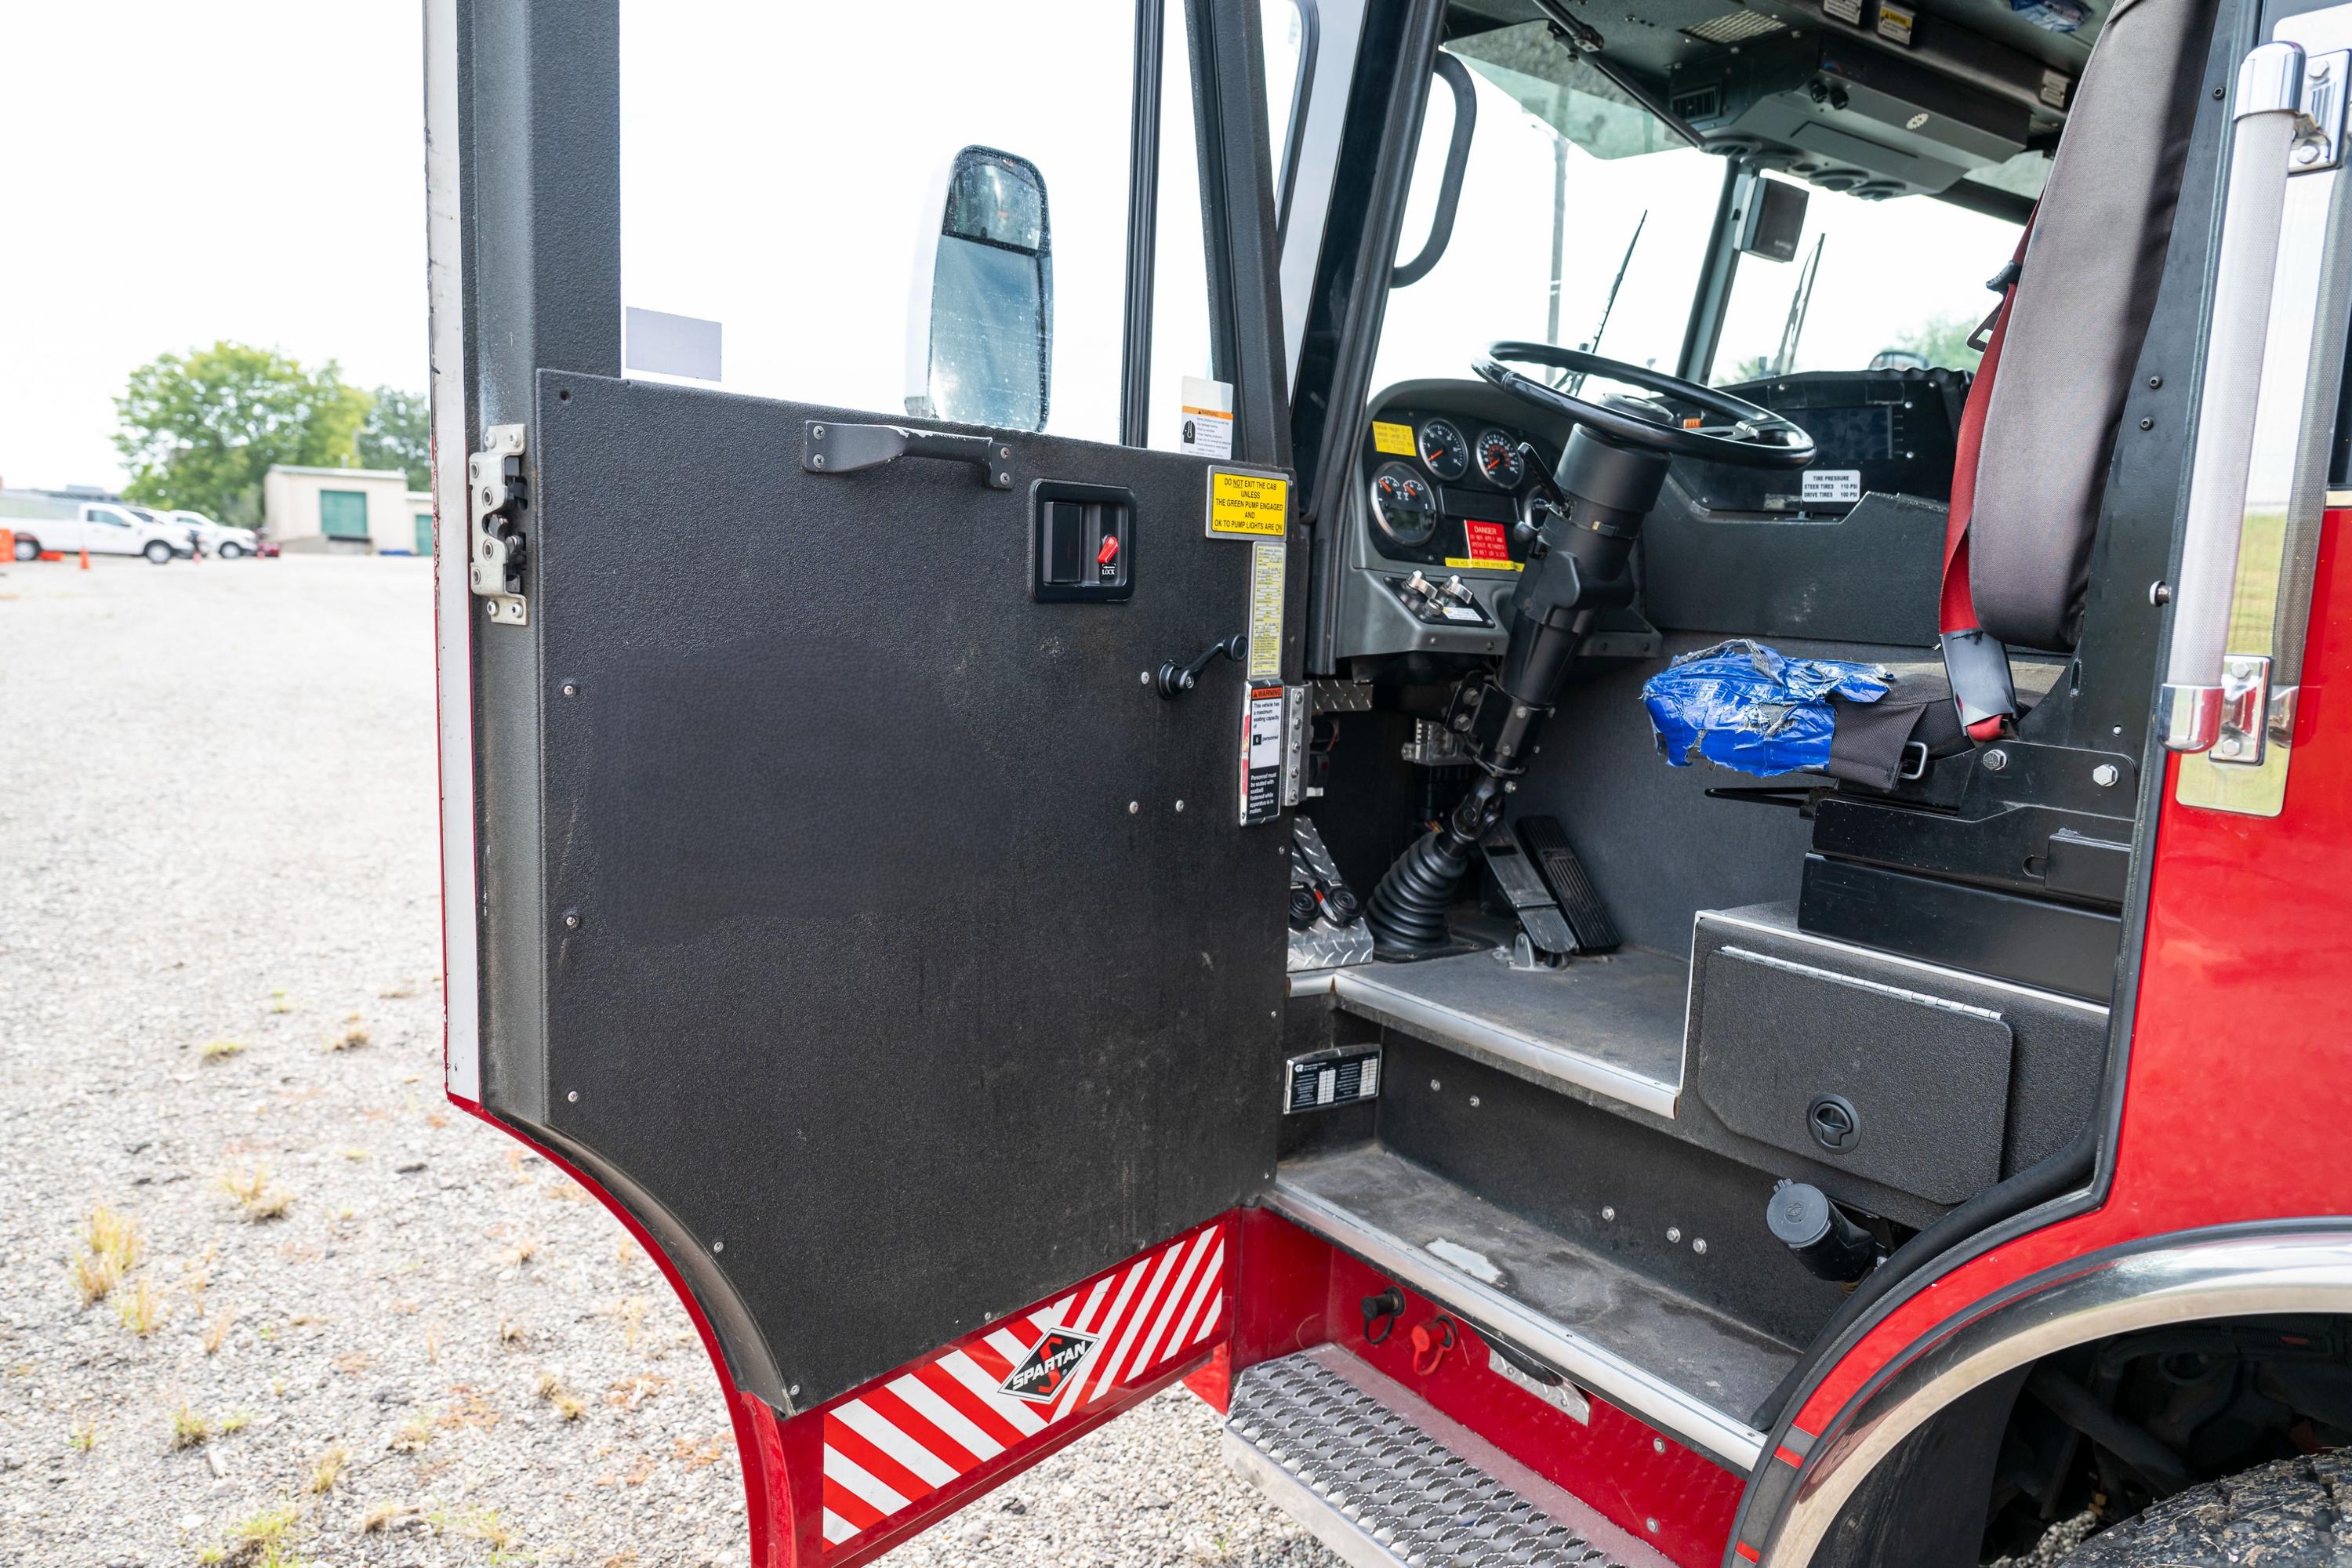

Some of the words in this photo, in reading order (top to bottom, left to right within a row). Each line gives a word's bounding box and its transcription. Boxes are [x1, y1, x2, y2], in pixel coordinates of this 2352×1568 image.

[1224, 477, 1232, 486] DO
[1244, 480, 1255, 488] EXIT
[1240, 490, 1261, 499] UNLESS
[1216, 498, 1226, 506] THE
[1226, 499, 1244, 508] GREEN
[1245, 500, 1259, 509] PUMP
[1259, 502, 1283, 511] ENGAGED
[1246, 521, 1264, 530] LIGHTS
[1474, 525, 1497, 535] DANGER
[1258, 688, 1282, 698] WARNING
[1012, 1340, 1086, 1391] SPARTAN
